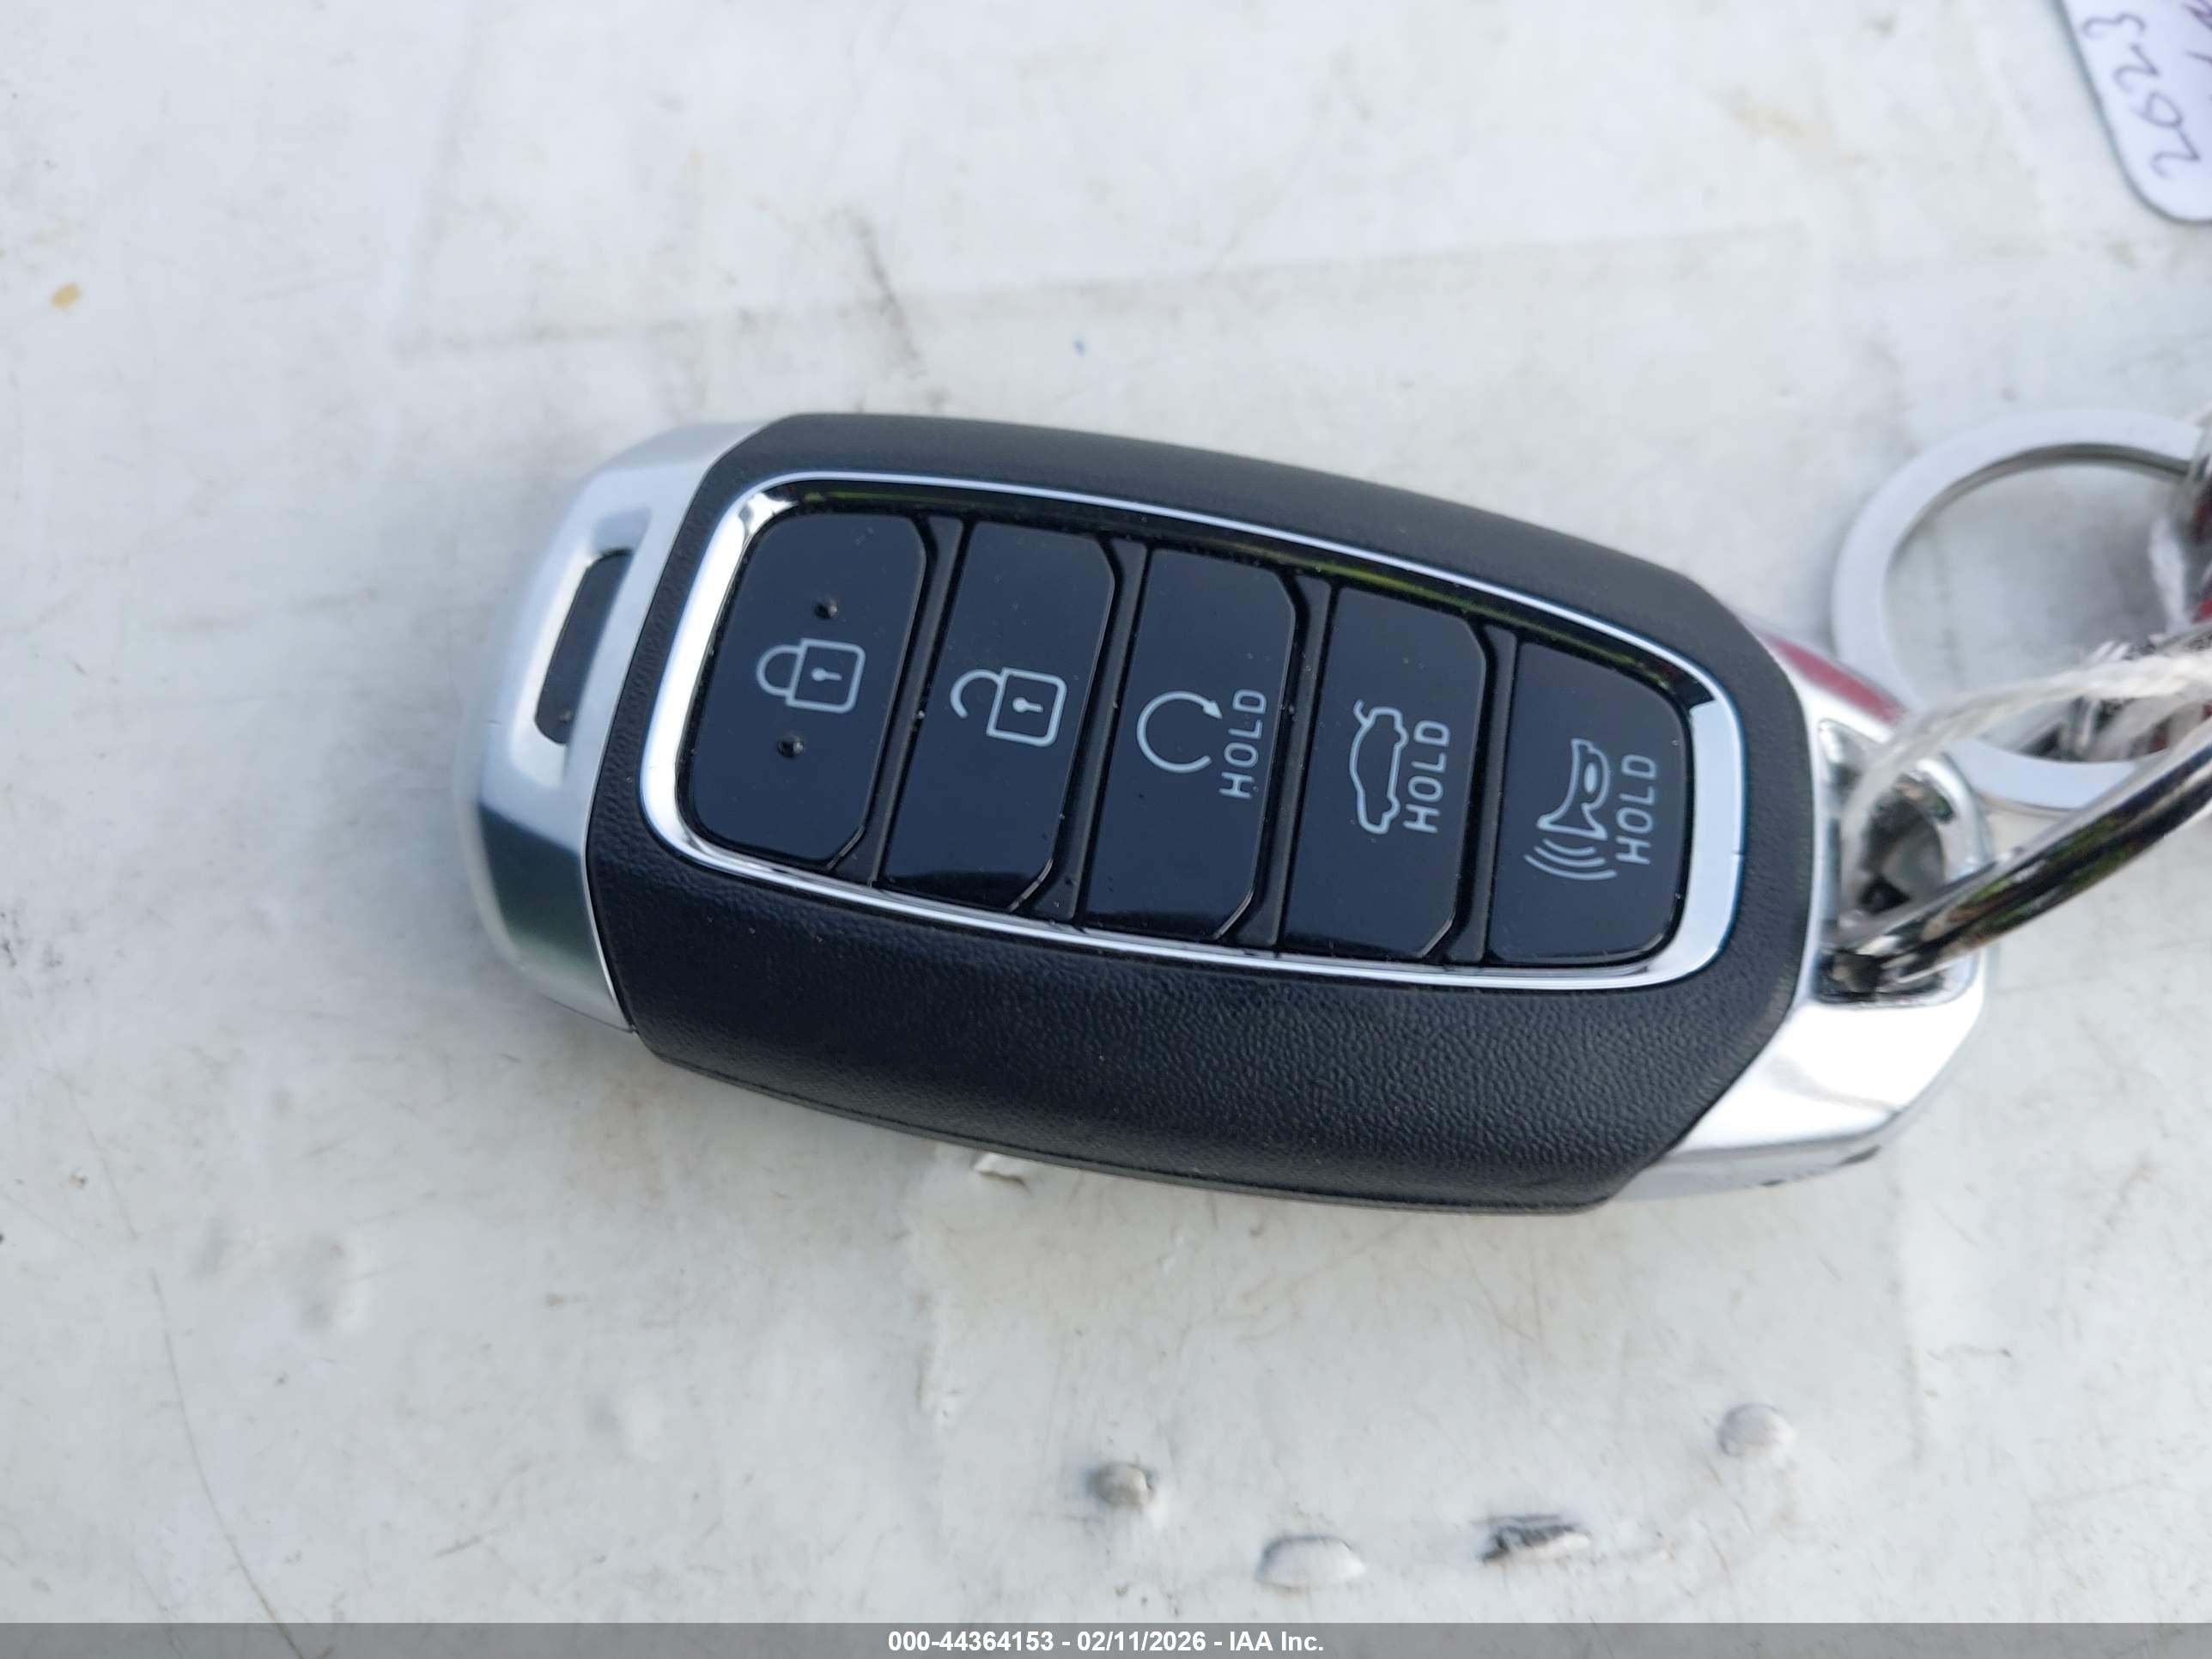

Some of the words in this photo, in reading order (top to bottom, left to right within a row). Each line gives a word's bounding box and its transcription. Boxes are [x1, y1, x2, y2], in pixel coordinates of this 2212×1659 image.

[1219, 689, 1267, 799] HOLD
[1403, 720, 1451, 833] HOLD
[1615, 754, 1658, 865] HOLD
